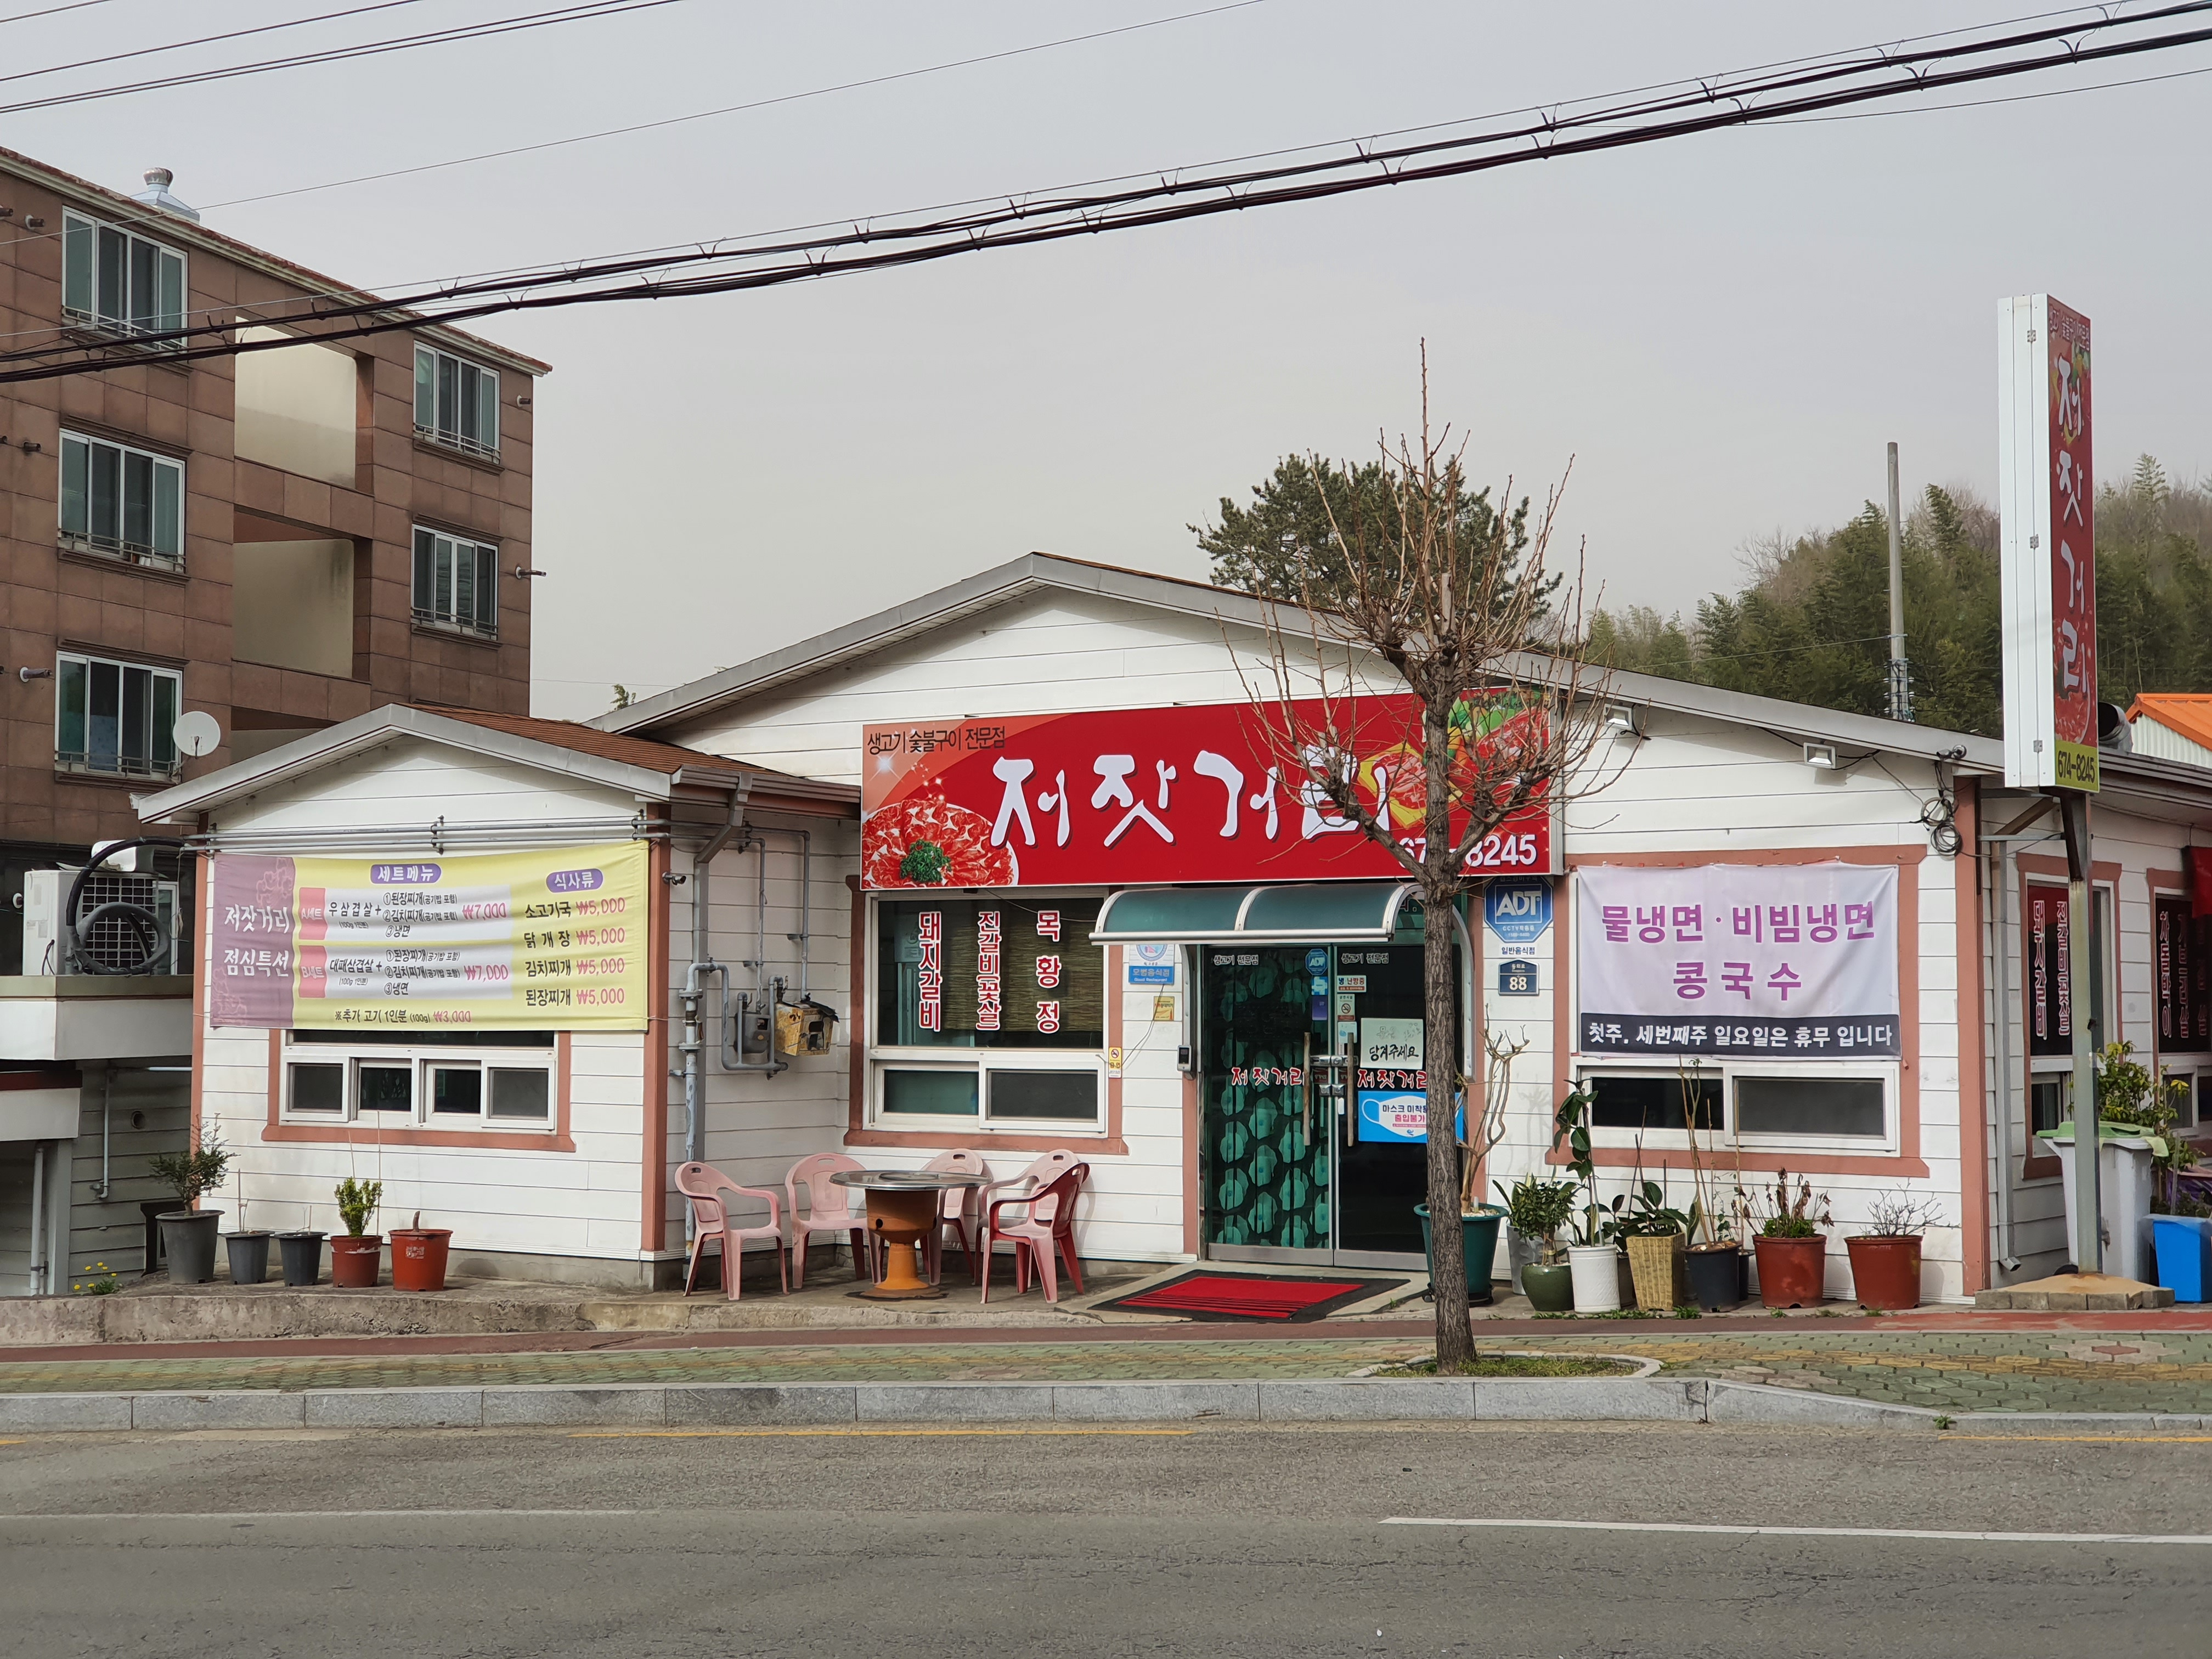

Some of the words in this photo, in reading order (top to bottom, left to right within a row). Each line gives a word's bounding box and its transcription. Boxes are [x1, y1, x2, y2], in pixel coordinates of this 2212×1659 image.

[2058, 356, 2086, 693] 저잣거리
[867, 731, 905, 755] 생고기
[909, 728, 961, 752] 숯불구이
[966, 726, 1005, 749] 전문점
[2057, 751, 2095, 783] 674-8245
[991, 744, 1390, 847] 저잣거리
[1396, 834, 1537, 868] 67-8245
[378, 866, 434, 883] 세트메뉴
[554, 871, 594, 890] 식사류
[462, 902, 507, 921] ₩7,000
[524, 901, 571, 918] 소고기국
[575, 897, 625, 917] ₩5,000
[1497, 890, 1542, 916] ADT
[224, 904, 290, 934] 저잣거리
[301, 907, 323, 920] A세트
[1601, 904, 1703, 944] 물냉면
[1732, 901, 1875, 944] 비빔냉면
[575, 927, 625, 947] ₩5,000
[1214, 955, 1234, 966] 생고기
[1237, 955, 1259, 965] 전문점
[1341, 953, 1363, 964] 생고기
[1366, 953, 1389, 963] 전문점
[1502, 946, 1536, 955] 일반음식점
[224, 949, 289, 977] 점심특선
[301, 966, 325, 979] B세트
[330, 958, 374, 973] 대패삼겹살
[525, 958, 571, 978] 김치찌개
[575, 957, 625, 977] ₩5,000
[918, 911, 943, 1032] 돼지갈비
[1132, 968, 1170, 977] 모범음식점
[2033, 900, 2047, 1040] 돼지갈비
[464, 964, 509, 983] ₩7,000
[1673, 962, 1802, 1001] 콩국수
[2160, 911, 2172, 1039] 차돌박이
[1509, 977, 1527, 991] 88
[525, 988, 571, 1007] 된장찌개
[575, 988, 625, 1007] ₩5,000
[364, 1009, 382, 1023] 고기
[385, 1009, 407, 1024] 1인분
[410, 1012, 431, 1024] (100g)
[433, 1010, 472, 1024] ₩3,000
[1636, 1025, 1707, 1045] 세번째주
[1714, 1025, 1788, 1048] 일요일은
[1794, 1026, 1831, 1048] 휴무
[1837, 1024, 1893, 1047] 입니다
[1369, 1043, 1419, 1062] 당겨주세요
[1383, 1104, 1404, 1113] 마스크
